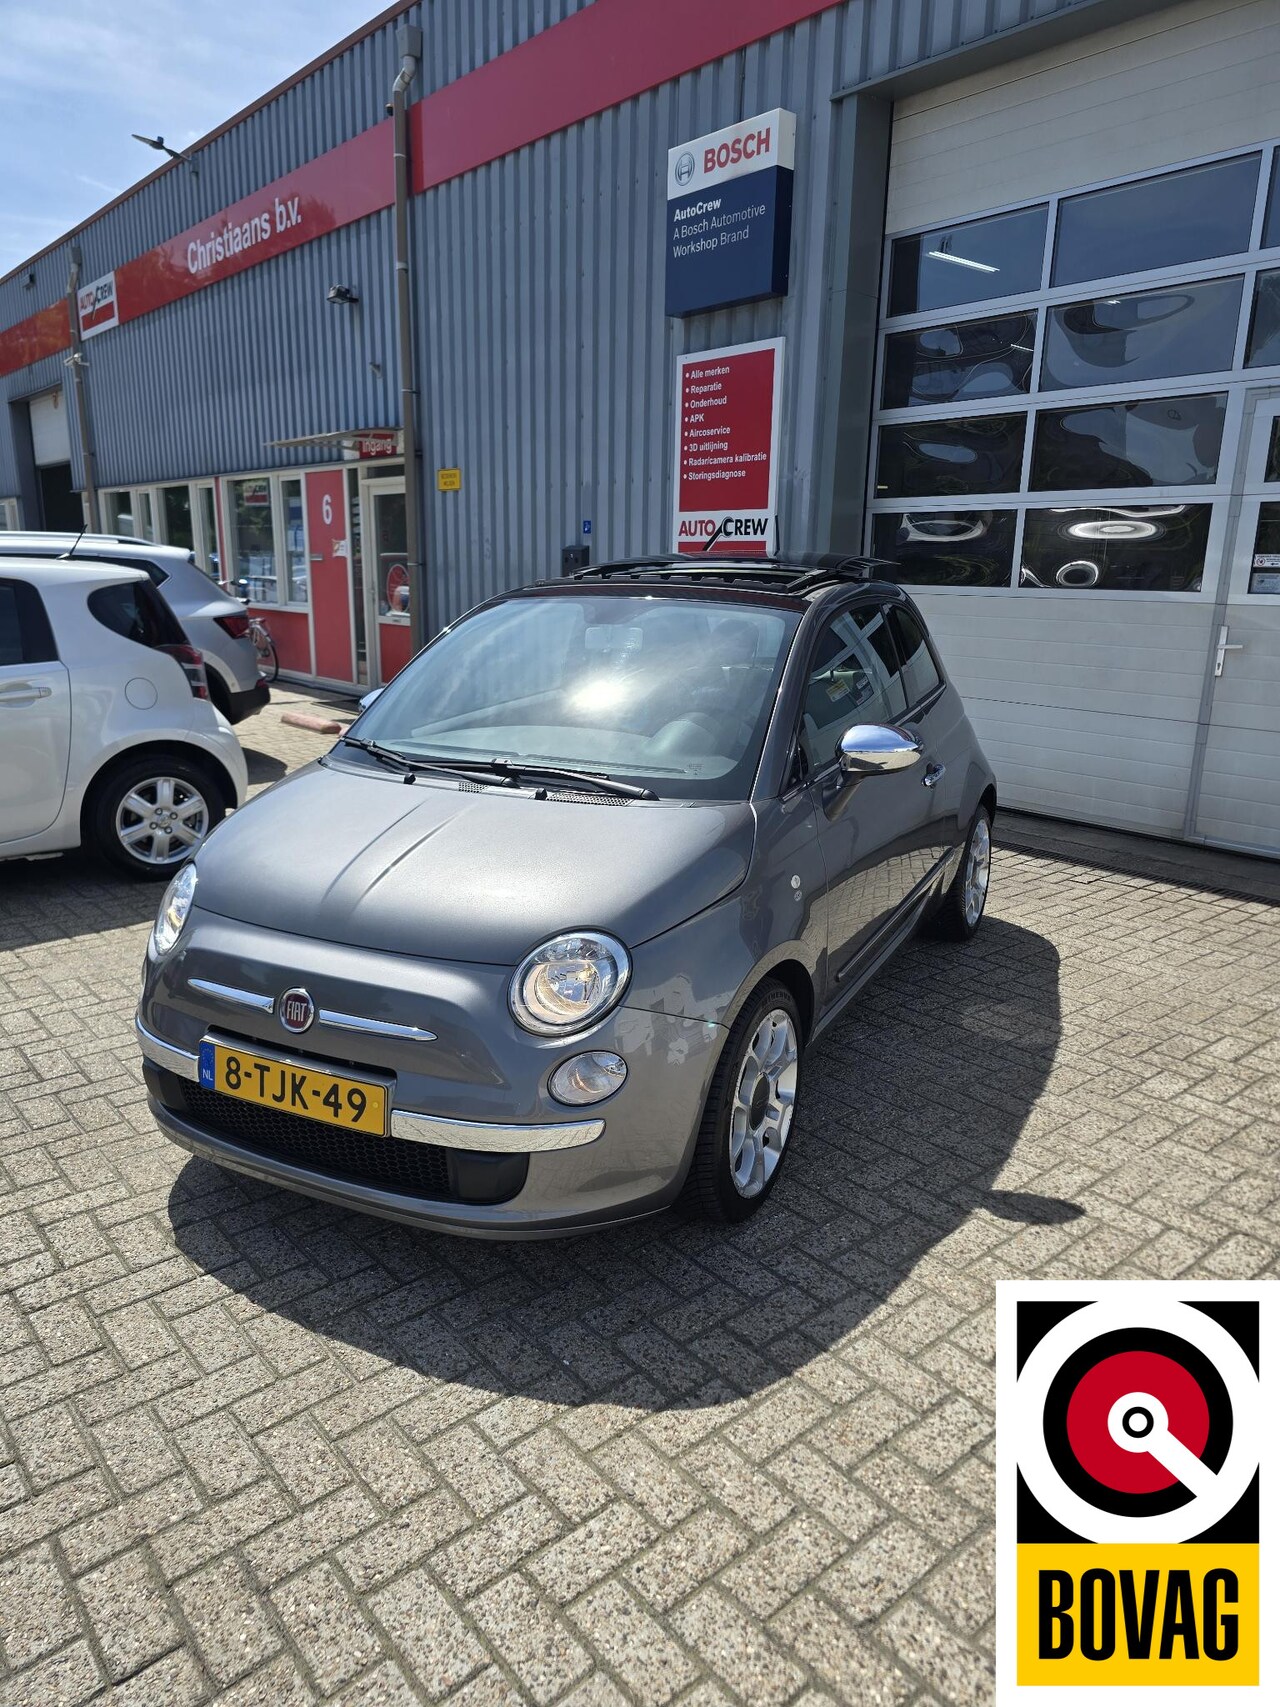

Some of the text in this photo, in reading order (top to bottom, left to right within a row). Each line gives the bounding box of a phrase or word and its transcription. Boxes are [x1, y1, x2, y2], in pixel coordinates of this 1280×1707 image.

[704, 127, 771, 173] BOSCH
[674, 199, 721, 222] AutoCrew
[673, 204, 766, 240] A Bosch Automotive
[187, 197, 302, 274] Christiaans b.v.
[673, 224, 749, 258] Workshop Brand
[690, 366, 730, 379] Alle merken
[690, 382, 722, 394] Reparatie
[690, 395, 727, 408] Onderhoud
[689, 413, 705, 423] APK
[689, 425, 731, 437] Aircoservice
[689, 441, 728, 452] 3D uitlijning
[688, 451, 767, 467] Radar/camera kalibratie
[688, 469, 746, 481] Storingsdiagnose
[322, 494, 333, 525] 6
[678, 517, 768, 537] AUTO CREW
[286, 1000, 307, 1022] FIAT
[202, 1067, 213, 1081] NL
[224, 1056, 367, 1123] 8-TJK-49
